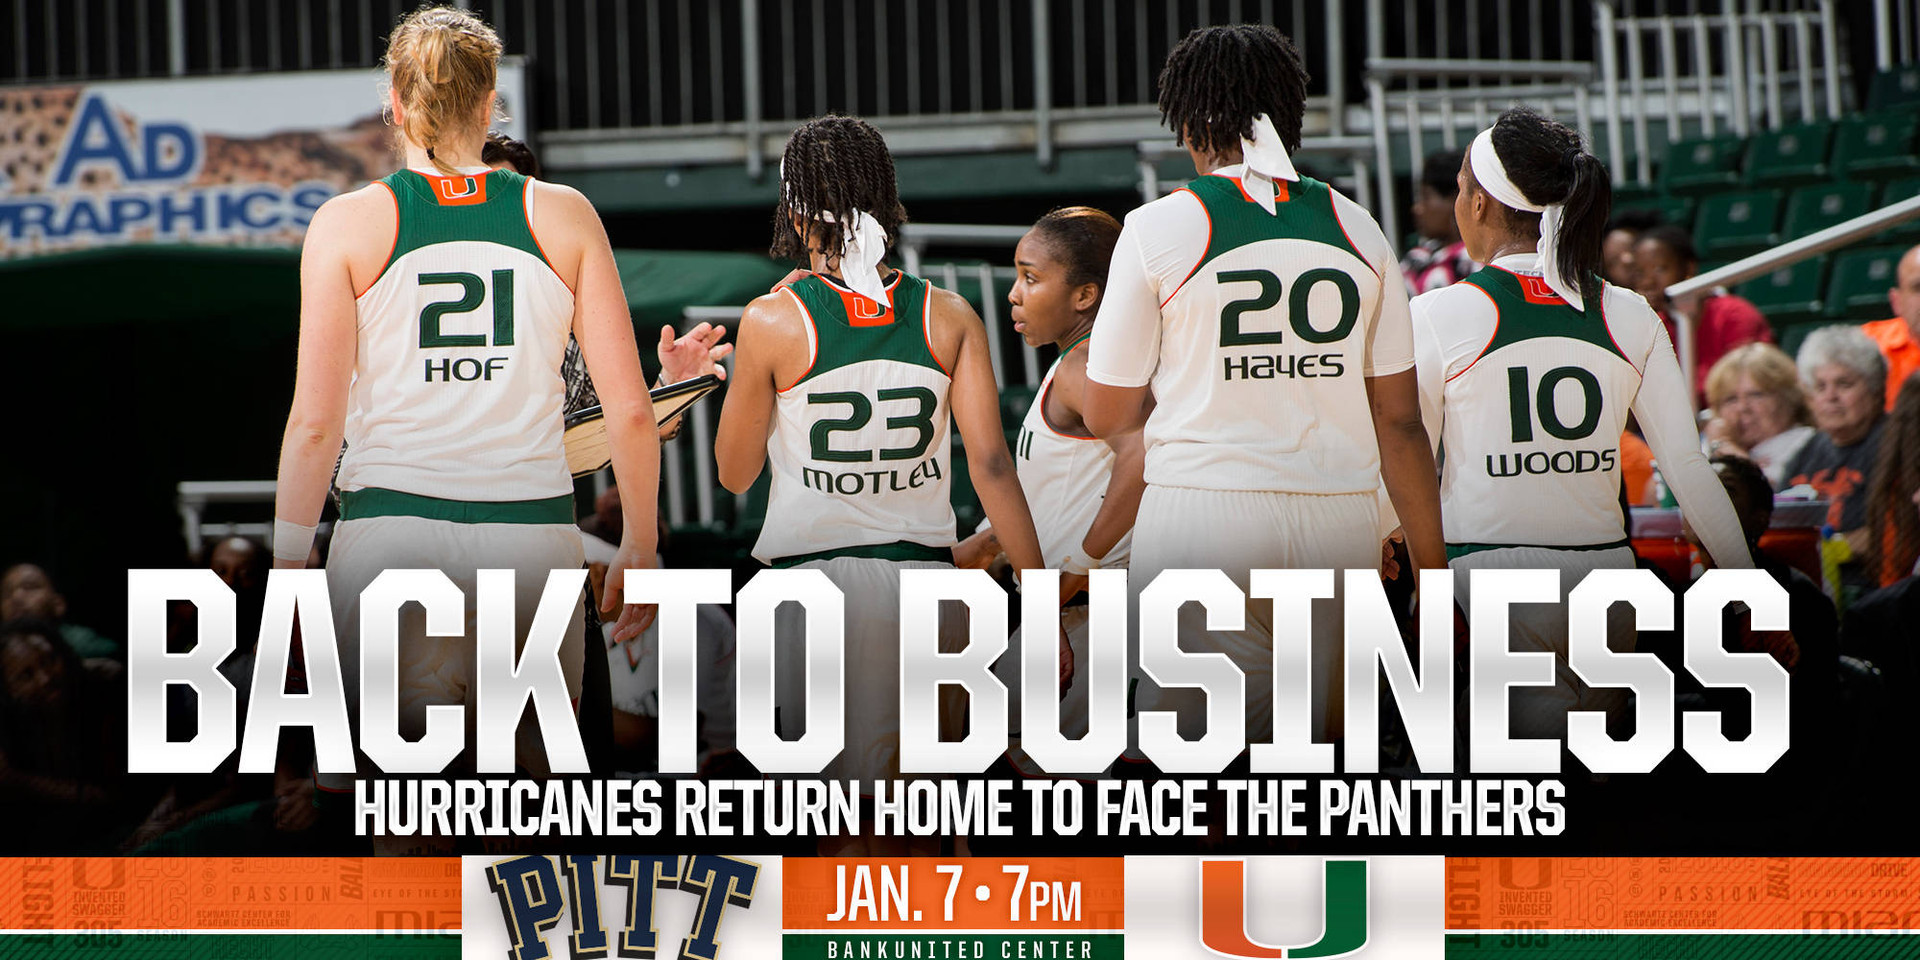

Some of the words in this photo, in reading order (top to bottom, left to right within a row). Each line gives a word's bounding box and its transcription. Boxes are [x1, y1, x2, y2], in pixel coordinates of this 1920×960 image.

[418, 268, 515, 349] 21
[1216, 267, 1361, 348] 20
[424, 357, 509, 382] HOF
[1507, 365, 1603, 443] 10
[807, 386, 938, 462] 23
[803, 457, 942, 495] MOTLEY
[1486, 448, 1616, 478] WOODS
